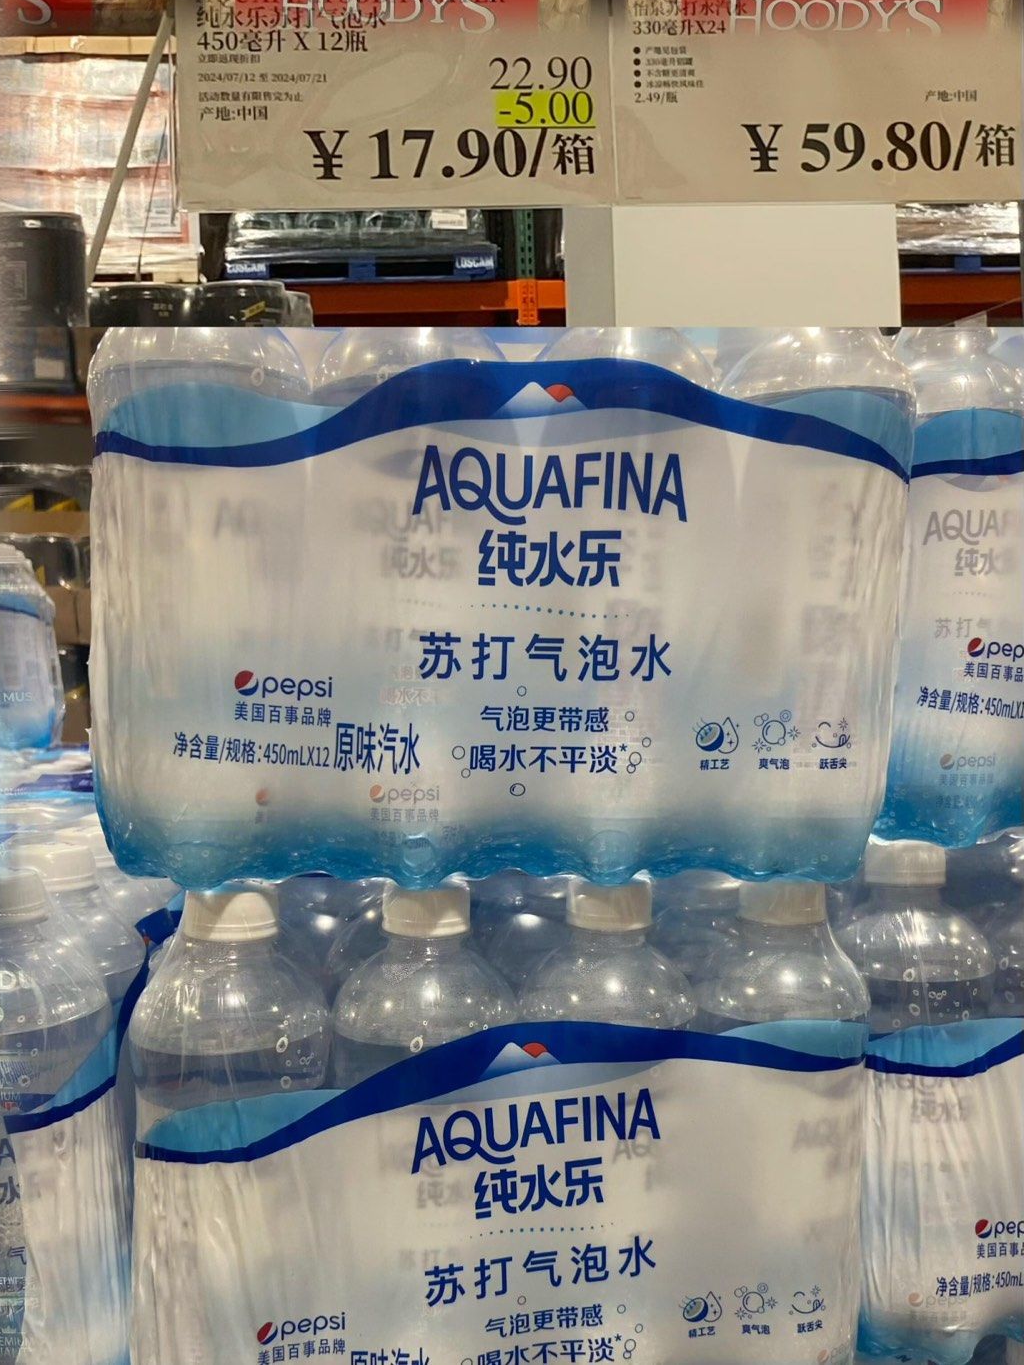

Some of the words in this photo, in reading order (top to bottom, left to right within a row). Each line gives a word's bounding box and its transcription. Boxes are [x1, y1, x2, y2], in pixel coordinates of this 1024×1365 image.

[197, 30, 286, 53] 450毫升
[294, 31, 310, 51] X
[318, 30, 368, 53] 12瓶
[197, 73, 256, 83] 2024/07/12
[271, 73, 327, 83] 2024/07/21
[488, 56, 593, 91] 22.90
[198, 91, 304, 103] 活动数量有限售完为止
[499, 91, 594, 125] -5.00
[925, 89, 978, 103] 产地:中国
[199, 105, 269, 122] 产地:中国
[369, 127, 596, 180] 17.90/箱
[800, 120, 1016, 173] 59.80/箱
[412, 444, 688, 525] AQUAFINA
[478, 529, 622, 588] 纯水乐
[418, 631, 672, 683] 苏打气泡水
[262, 676, 333, 701] pepsi
[234, 701, 332, 727] 美国百事品牌
[480, 706, 610, 733] 气泡更带感
[173, 731, 331, 768] 净含量/规格:450mLX12
[334, 722, 421, 775] 原味汽水
[699, 758, 730, 771] 精工艺
[758, 758, 790, 771] 爽气泡
[819, 758, 848, 771] 跃舌尖
[411, 1087, 661, 1175] AQUAFINA
[474, 1156, 604, 1220] 纯水乐
[425, 1236, 656, 1308] 苏打气泡水
[280, 1312, 346, 1341] pepsi
[485, 1304, 604, 1338] 气泡更带感
[688, 1325, 716, 1339] 精工艺
[741, 1323, 771, 1336] 爽气泡
[797, 1321, 824, 1334] 跃舌尖
[257, 1338, 346, 1365] 美国百事品牌
